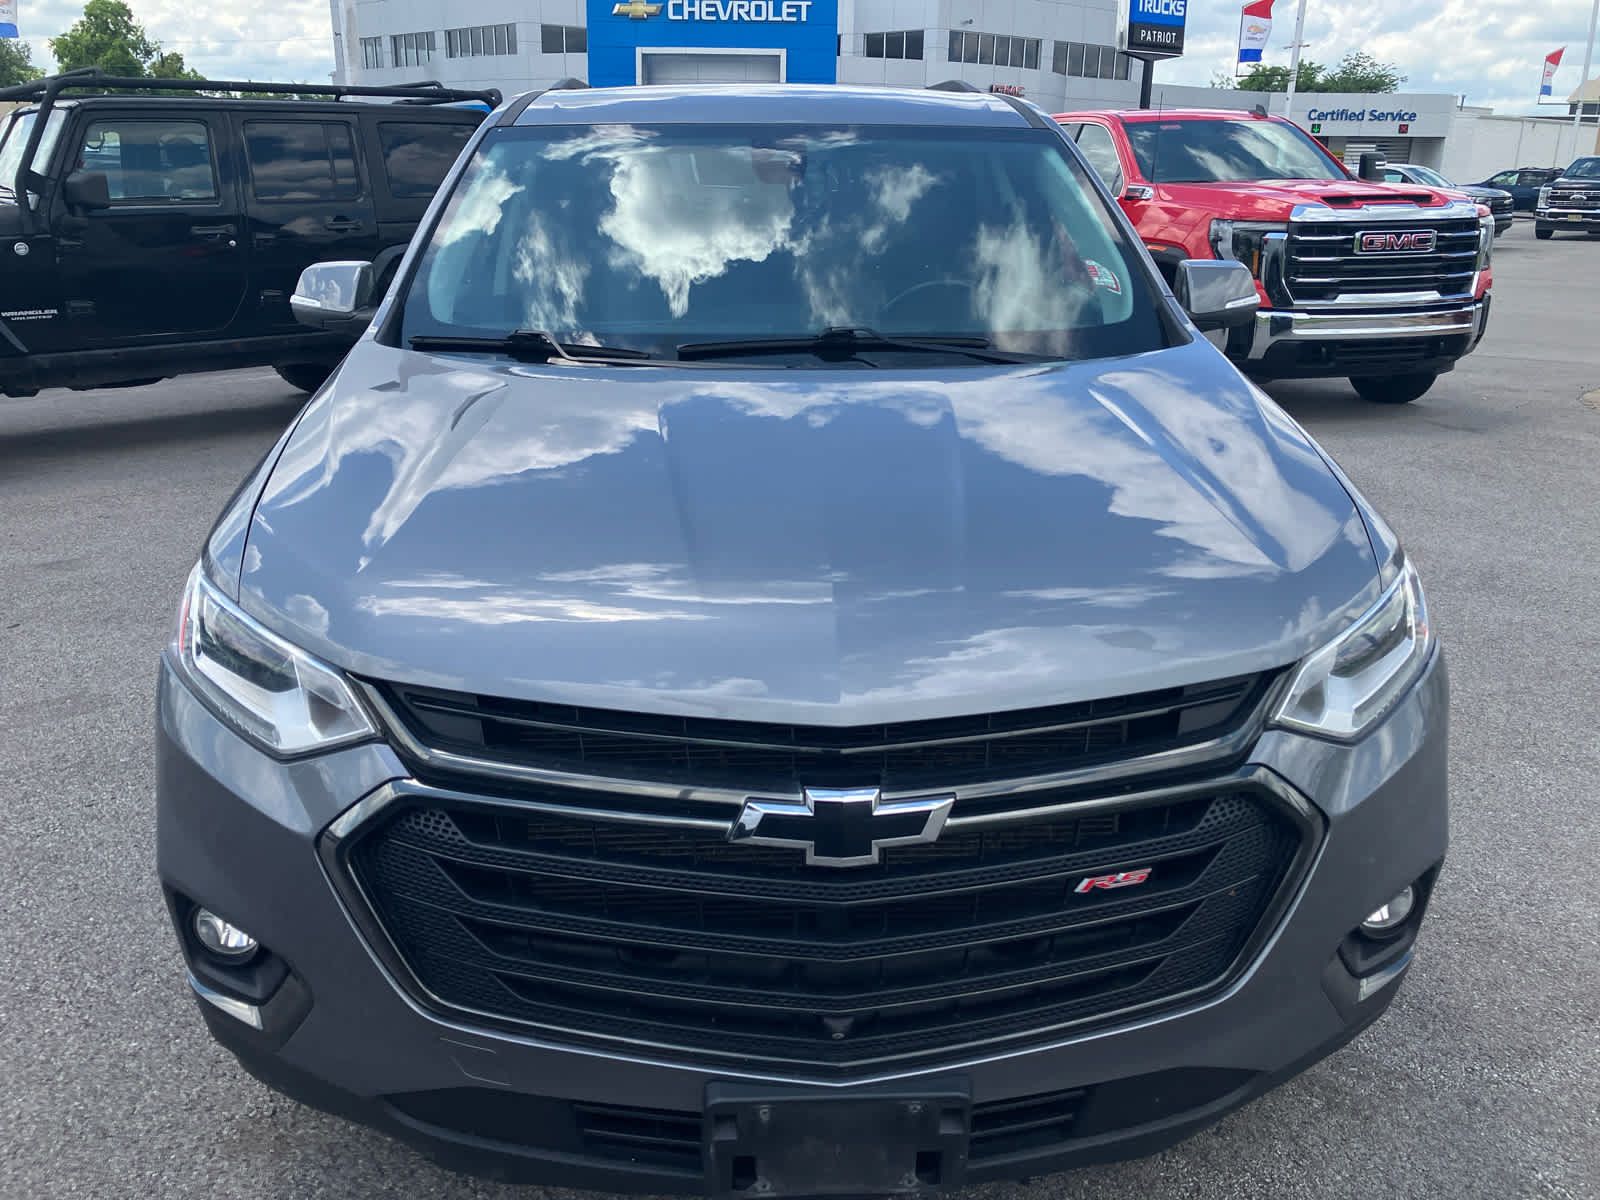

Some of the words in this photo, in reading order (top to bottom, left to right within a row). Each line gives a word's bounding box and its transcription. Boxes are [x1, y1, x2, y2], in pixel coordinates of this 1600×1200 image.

[667, 0, 812, 21] CHEVROLET
[1138, 0, 1185, 16] TRUCKS
[1140, 29, 1177, 44] PATRIOT
[1308, 108, 1366, 121] Certified
[1368, 109, 1417, 121] Service
[1362, 233, 1433, 251] GMC
[1, 309, 58, 317] WRANGLER
[1074, 867, 1153, 893] RS
